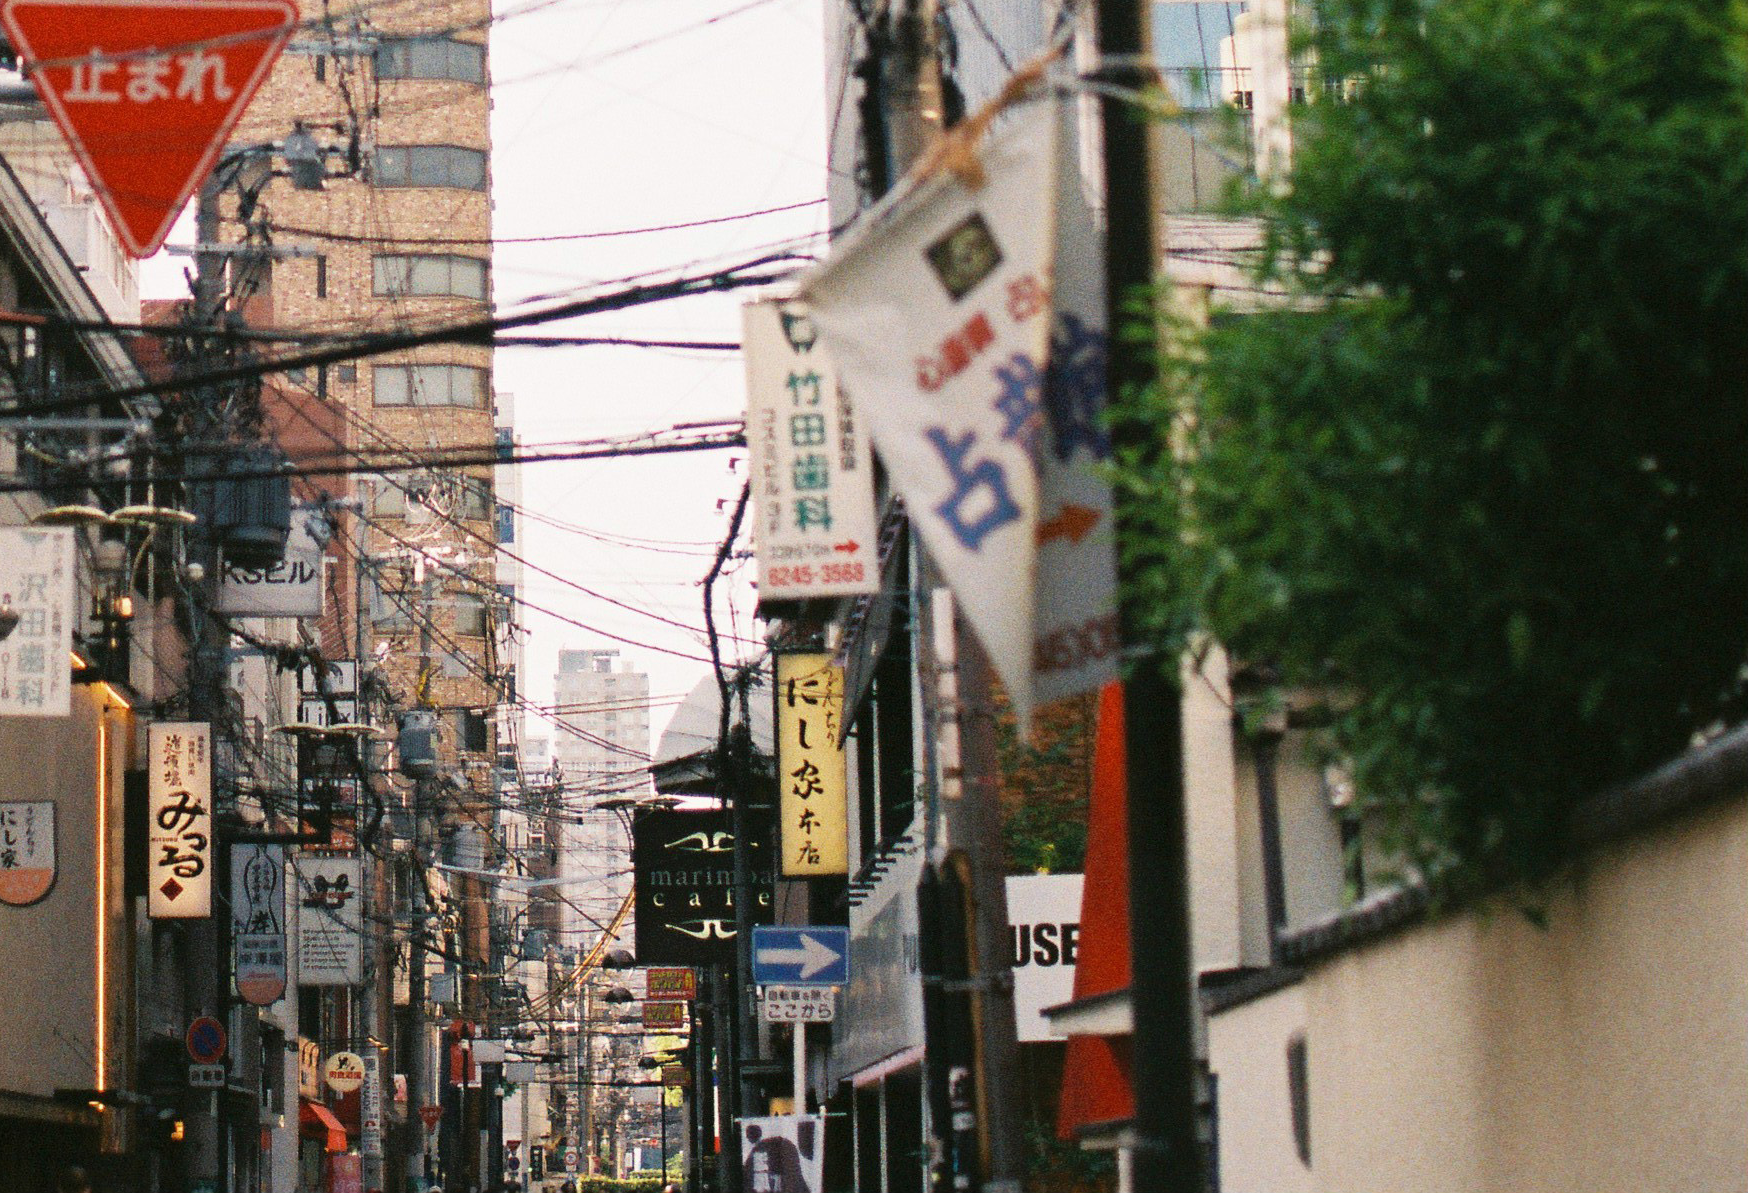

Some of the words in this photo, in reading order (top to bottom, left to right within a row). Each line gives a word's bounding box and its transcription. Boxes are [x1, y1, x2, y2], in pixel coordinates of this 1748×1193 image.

[63, 47, 234, 104] 止まれ
[788, 677, 824, 865] にし家本店
[0, 810, 21, 869] にし家
[768, 1003, 832, 1019] ここから
